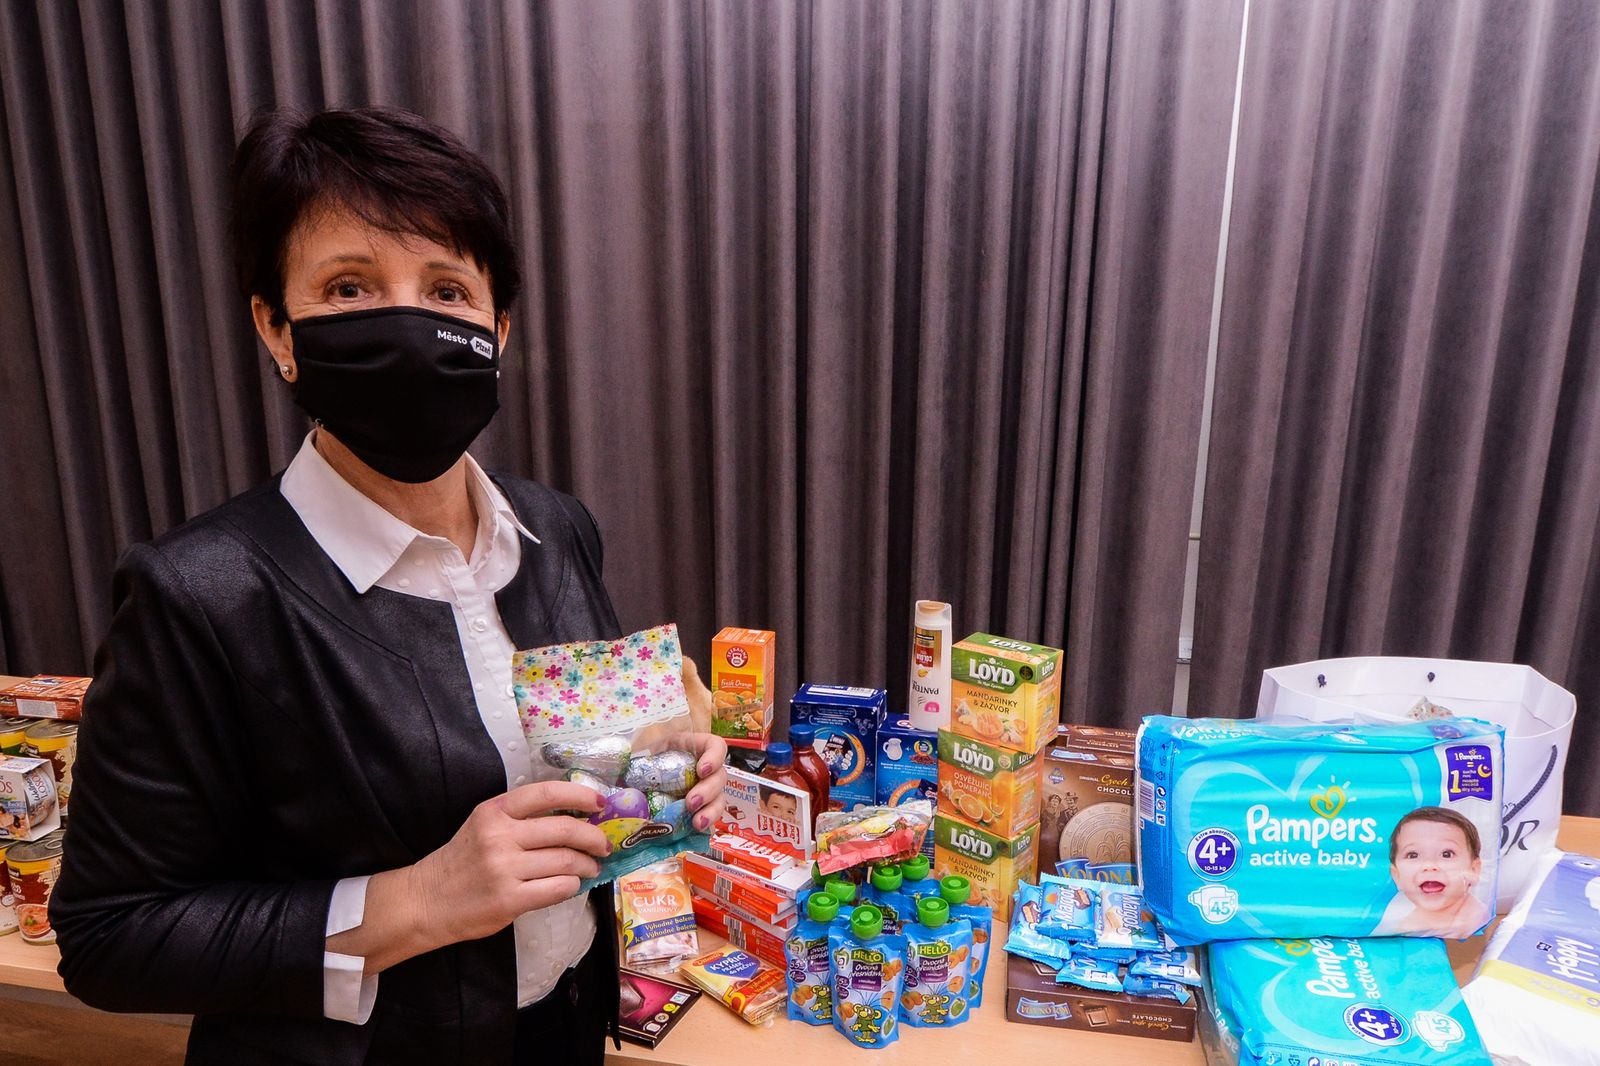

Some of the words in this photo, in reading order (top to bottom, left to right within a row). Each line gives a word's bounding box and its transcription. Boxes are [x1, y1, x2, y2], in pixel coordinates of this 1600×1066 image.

[437, 329, 468, 345] Město
[475, 340, 491, 355] Plzeň
[988, 639, 1032, 651] LOYD
[969, 658, 1016, 687] LOYD
[721, 679, 735, 688] Fresh
[735, 680, 753, 688] Orange
[966, 690, 1018, 708] MANDARINKY
[953, 742, 994, 772] LOYD
[726, 779, 747, 791] nder
[1101, 774, 1128, 786] Czech
[1450, 770, 1461, 793] 1
[724, 786, 757, 804] HOCOLATE
[1097, 786, 1135, 796] CHOCOL
[1195, 831, 1208, 842] Extra
[1209, 829, 1236, 842] absorption
[1246, 804, 1378, 849] Pampers
[951, 828, 992, 858] LOYD
[1199, 838, 1231, 864] 4+
[947, 856, 996, 878] MANDARINKY
[1250, 850, 1311, 866] active
[1318, 850, 1371, 868] baby
[633, 895, 677, 908] CUKR
[1055, 884, 1077, 922] Margot
[1211, 901, 1230, 915] 45
[1117, 893, 1141, 935] Margot
[853, 951, 881, 963] HELLO
[920, 945, 949, 955] HELLO
[1343, 938, 1365, 958] ba
[855, 963, 879, 972] Ovocná
[1354, 959, 1381, 1000] active
[723, 985, 746, 1013] 5
[1132, 1014, 1173, 1023] CHOCOLATE
[1358, 1010, 1389, 1038] 4+
[1433, 1016, 1451, 1034] 45
